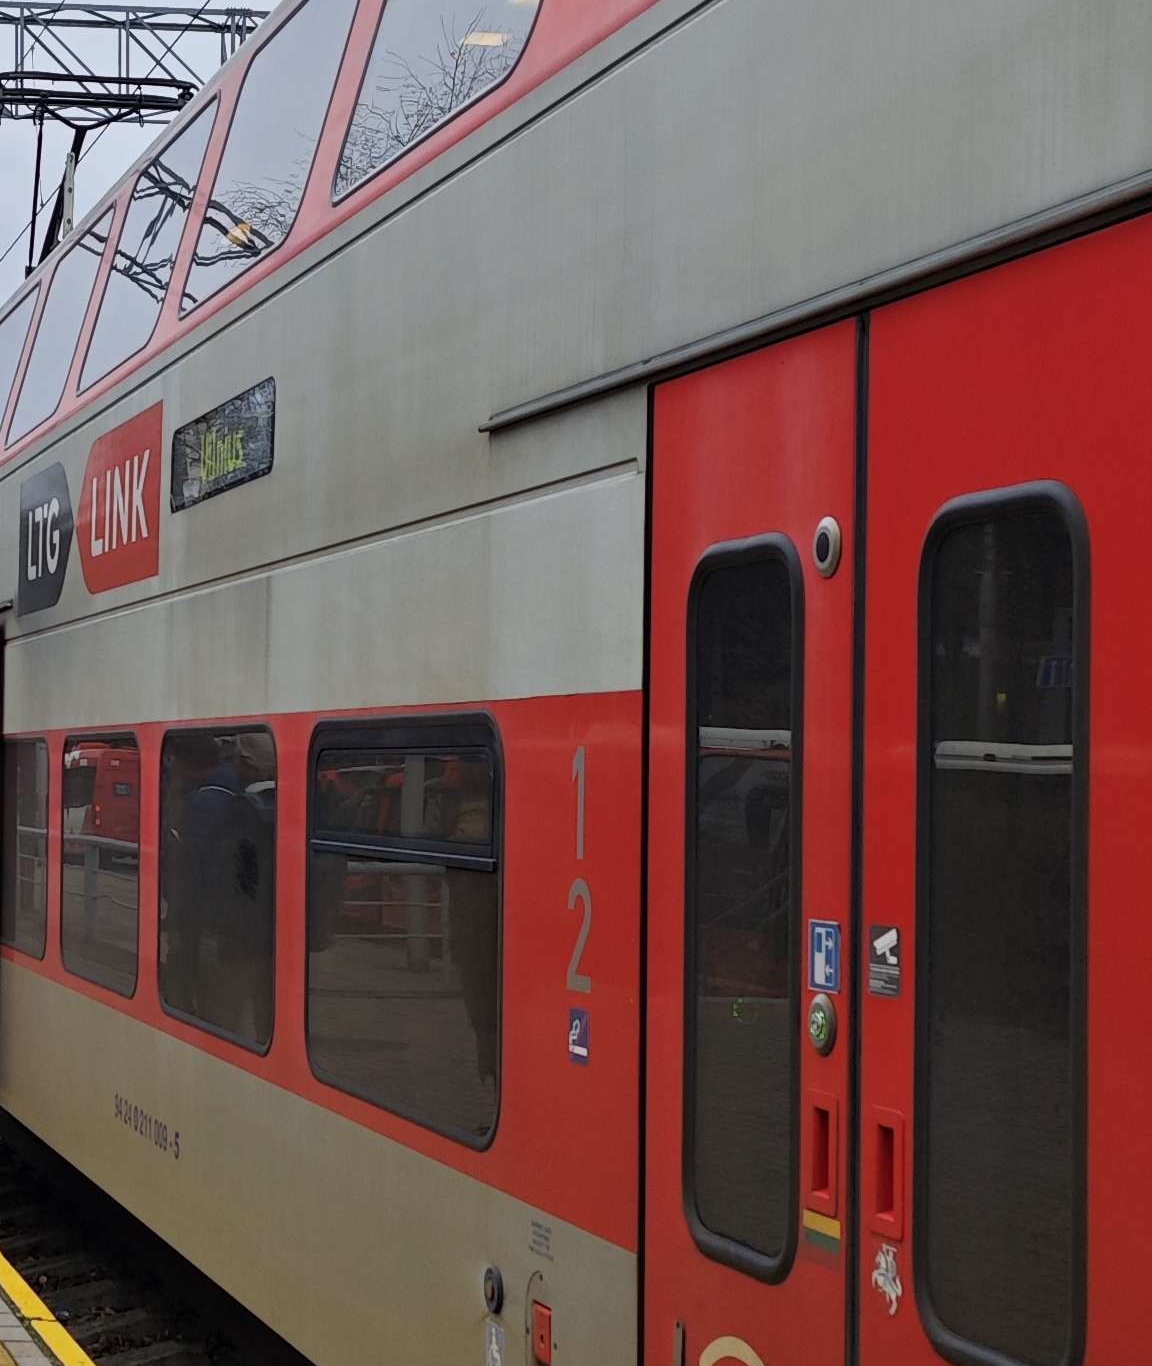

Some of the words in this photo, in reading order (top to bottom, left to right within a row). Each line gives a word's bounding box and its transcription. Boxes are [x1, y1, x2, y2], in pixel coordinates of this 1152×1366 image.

[27, 497, 60, 581] LTG
[91, 448, 150, 557] LINK
[572, 745, 585, 860] 1
[566, 878, 592, 995] 2
